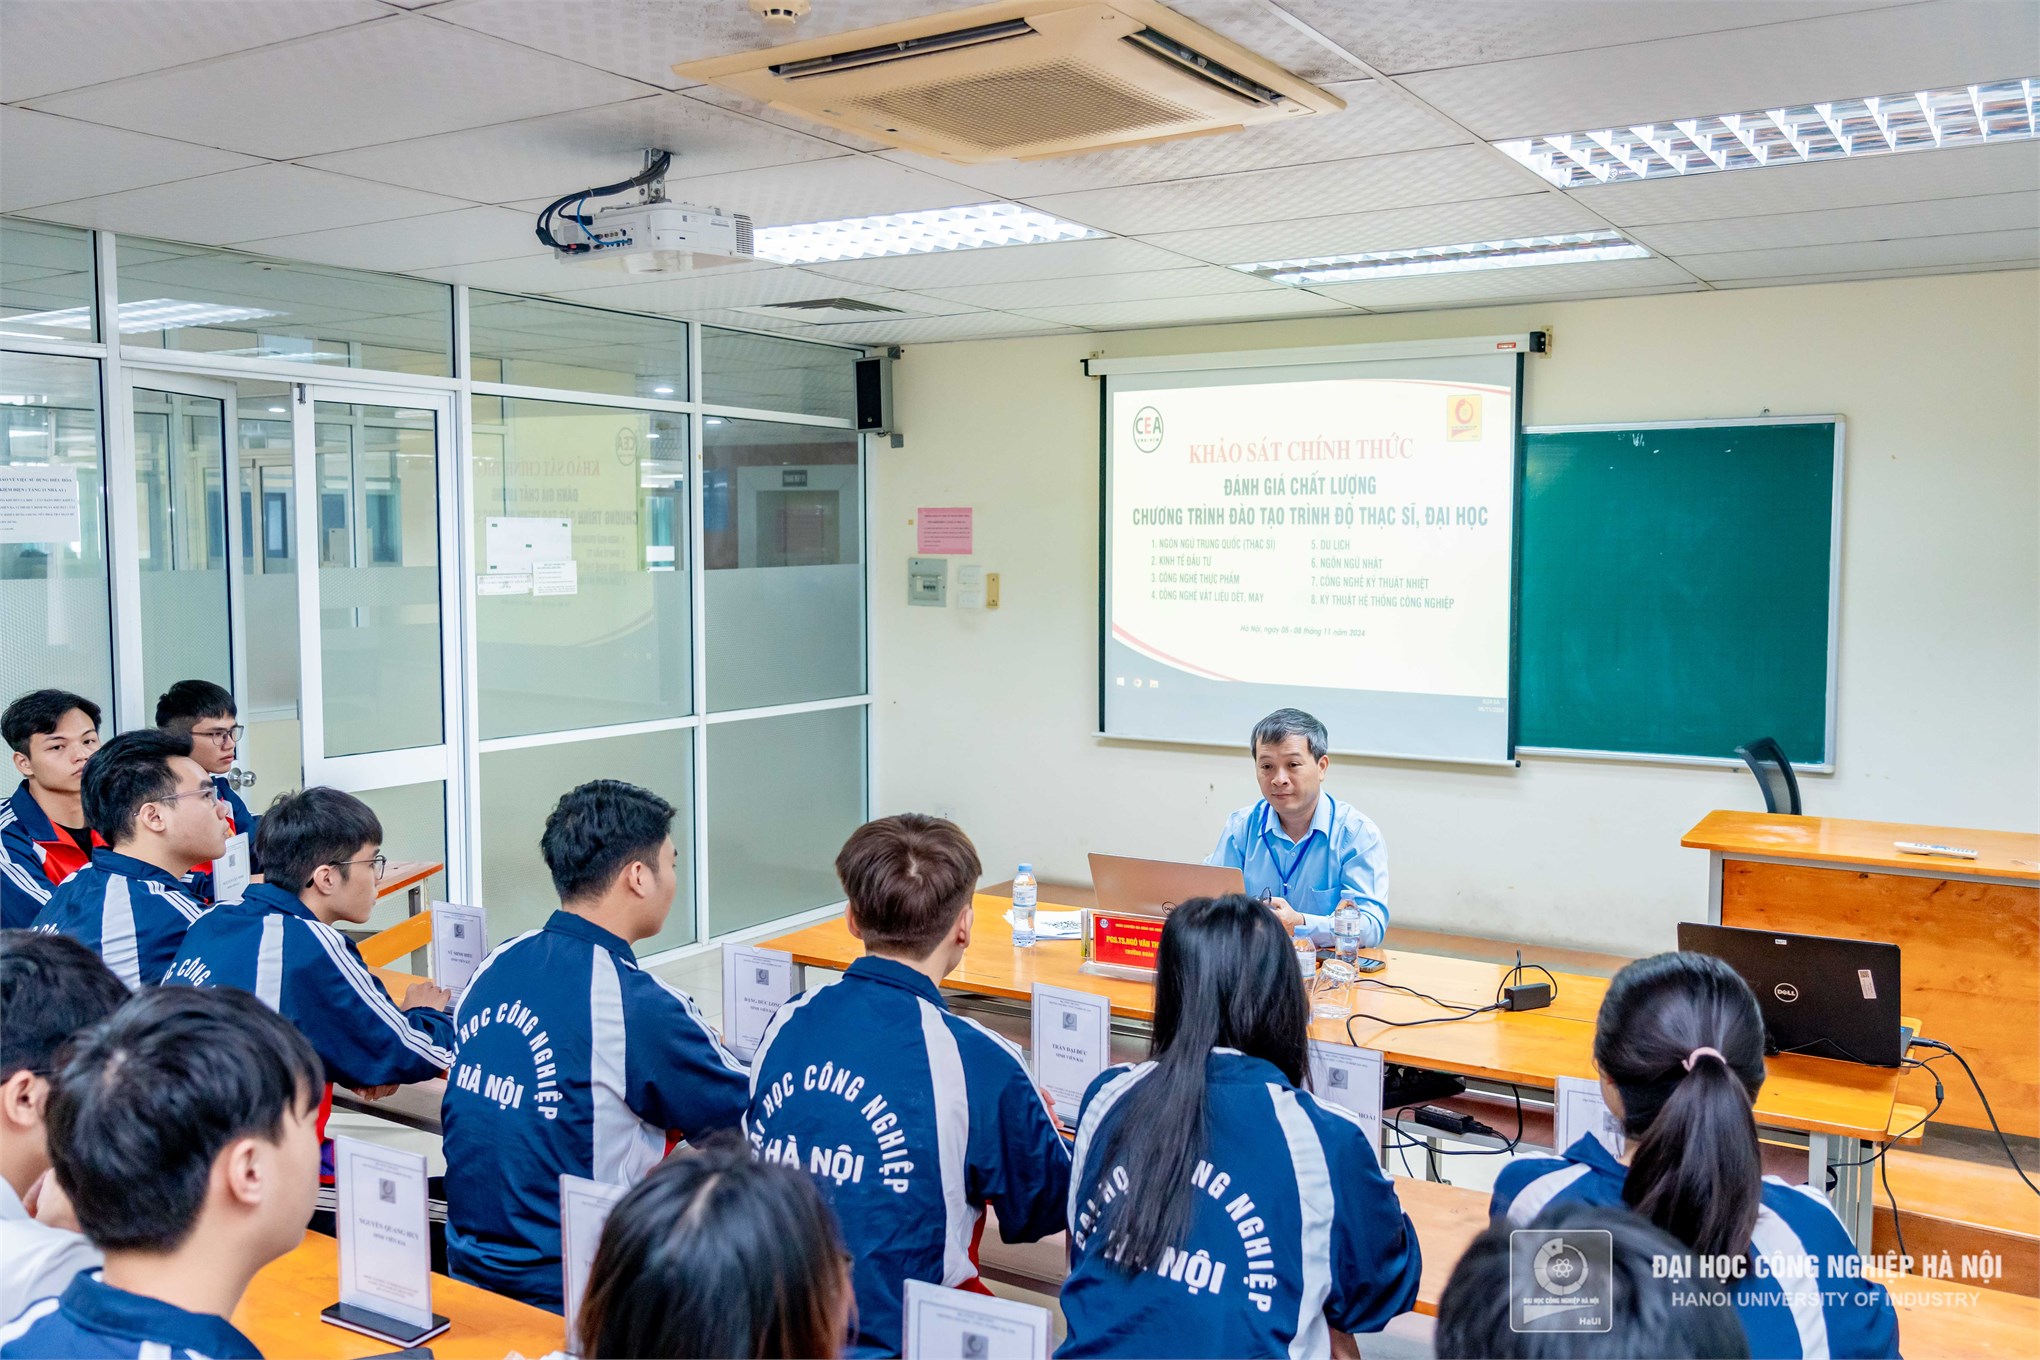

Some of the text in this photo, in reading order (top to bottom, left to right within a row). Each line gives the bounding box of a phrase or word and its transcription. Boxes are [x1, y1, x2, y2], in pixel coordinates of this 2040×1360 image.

[1136, 417, 1162, 434] CEA
[1189, 432, 1413, 464] KHẢO SÁT CHÍNH THỨC
[1224, 470, 1376, 499] ĐÁNH GIÁ CHẤT LƯỢNG
[1132, 502, 1488, 530] CHƯƠNG TRÌNH ĐÀO TẠO TRÌNH ĐỘ THẠC SĨ, ĐẠI HỌC
[1196, 539, 1220, 549] TRUNG
[1311, 539, 1318, 550] 5.
[1320, 540, 1331, 550] DU
[1151, 556, 1158, 566] 2.
[1159, 556, 1174, 566] KINH
[1311, 557, 1318, 568] 6.
[1320, 555, 1341, 568] NGÔN
[1151, 573, 1158, 582] 3.
[1158, 571, 1177, 583] CÔNG
[1311, 576, 1318, 587] 7.
[1320, 573, 1340, 587] CÔNG
[1151, 590, 1158, 599] 4.
[1248, 592, 1264, 602] MAY
[177, 957, 211, 987] CÔNG
[460, 999, 563, 1120] HỌC CÔNG NGHIỆP
[456, 1063, 524, 1110] HÀ NỘI
[762, 1072, 794, 1118] HỌC
[803, 1060, 865, 1102] CÔNG
[861, 1094, 914, 1193] NGHIỆP
[765, 1134, 864, 1186] HÀ NỘI
[1098, 1165, 1129, 1205] HỌ
[1191, 1159, 1231, 1199] NG
[1225, 1193, 1277, 1312] NGHIỆP
[1157, 1246, 1226, 1295] NỘI
